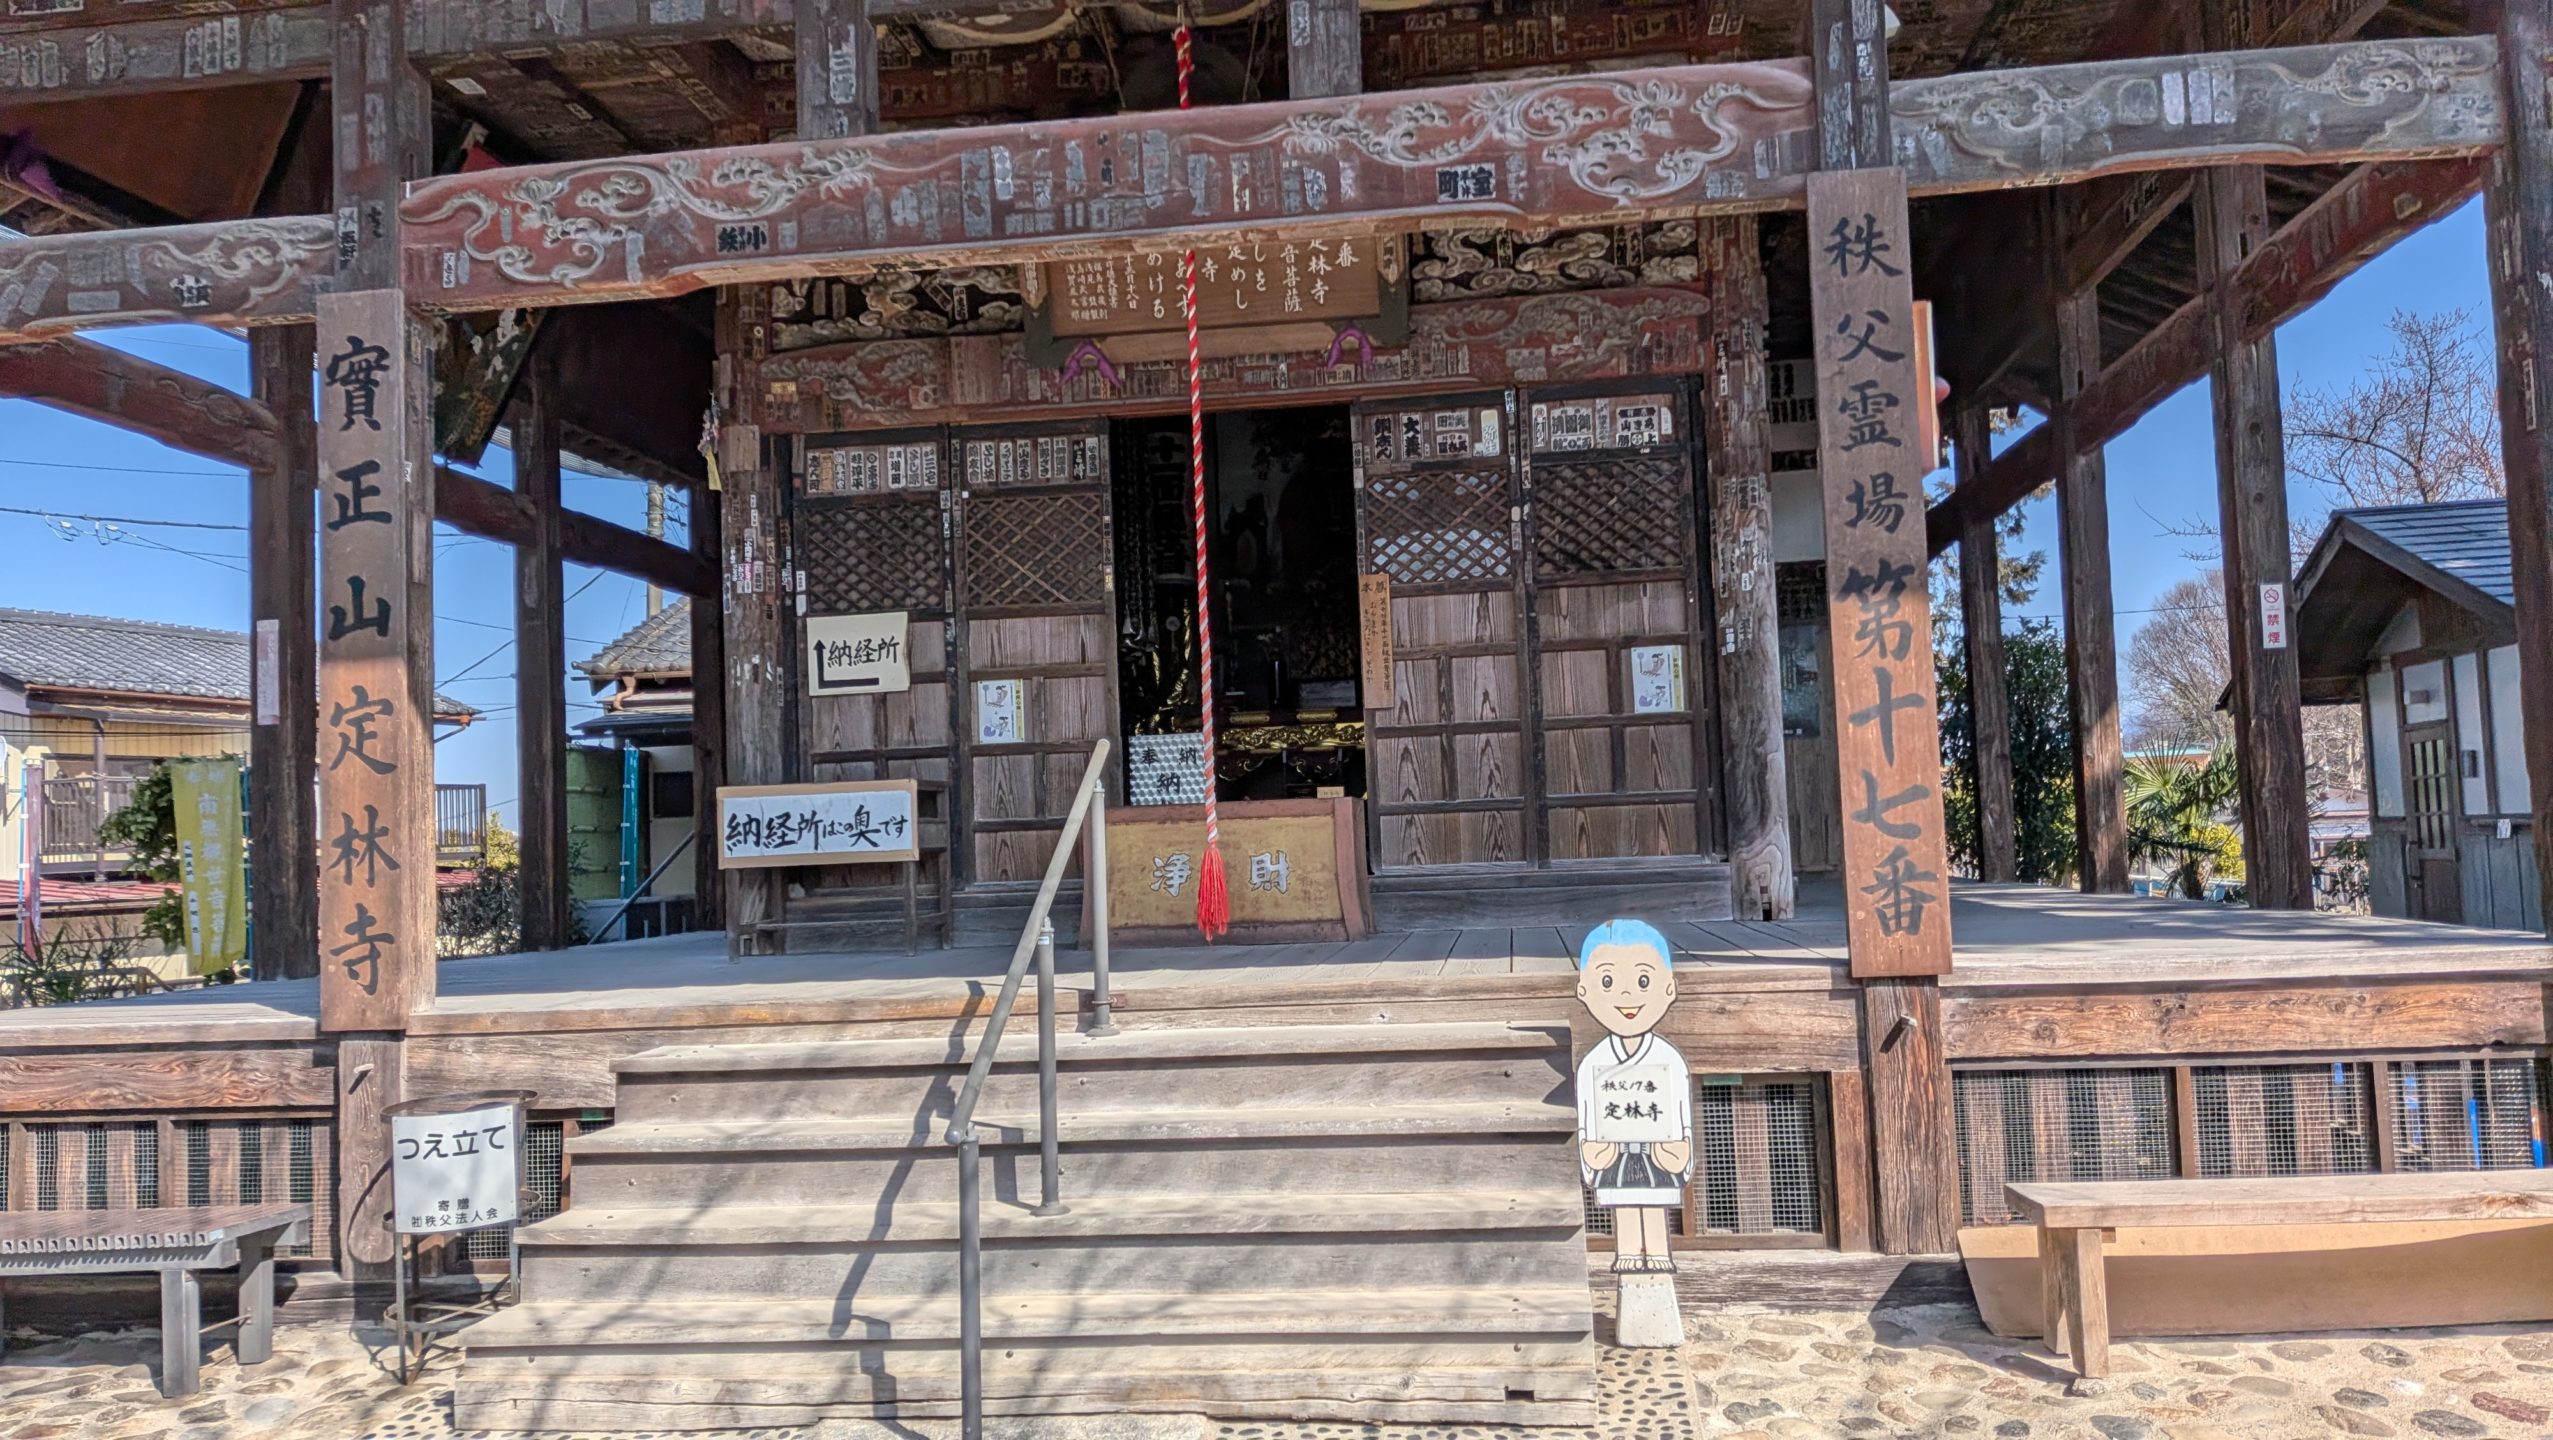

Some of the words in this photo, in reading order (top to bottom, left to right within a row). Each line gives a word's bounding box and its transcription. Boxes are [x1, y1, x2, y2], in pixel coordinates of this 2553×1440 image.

[1202, 257, 1219, 283] 寺
[1823, 215, 1937, 937] 秩父霊場第十七番
[2267, 614, 2281, 645] 禁煙
[325, 336, 400, 995] 實正山定林寺
[827, 636, 900, 668] 納経所
[725, 804, 909, 856] 納経所はこの奥です
[1600, 1080, 1658, 1093] 秩父17番
[1603, 1101, 1664, 1122] 定林寺
[397, 1125, 506, 1160] つえ立て
[438, 1198, 470, 1212] 寄贈
